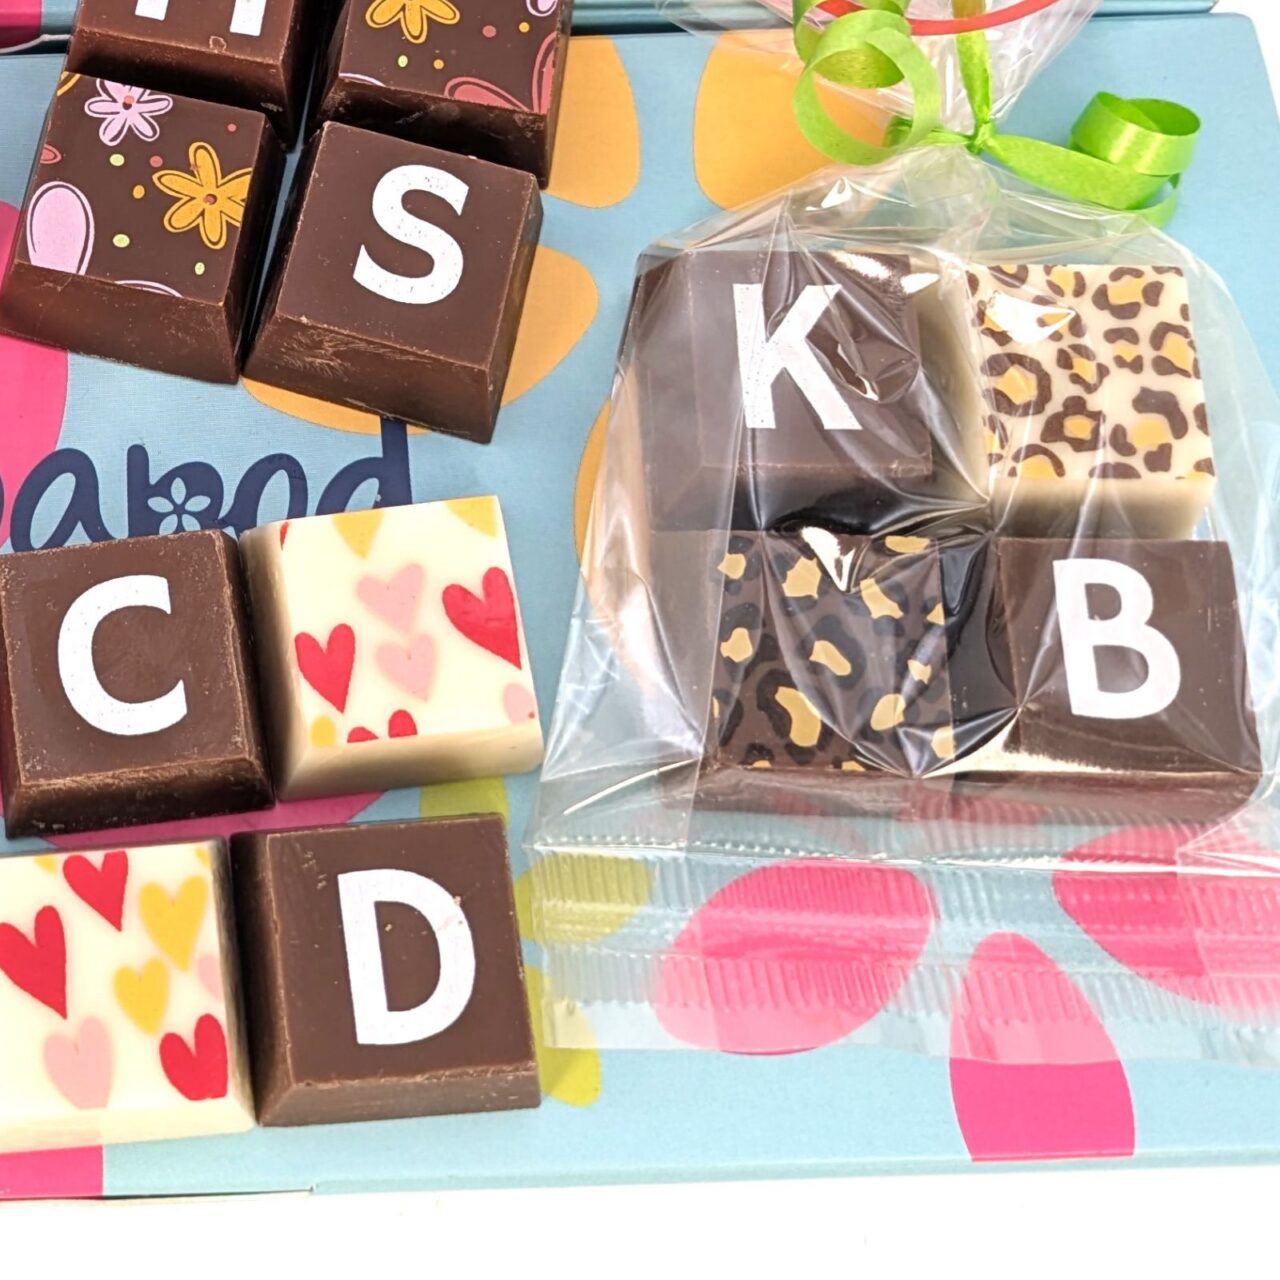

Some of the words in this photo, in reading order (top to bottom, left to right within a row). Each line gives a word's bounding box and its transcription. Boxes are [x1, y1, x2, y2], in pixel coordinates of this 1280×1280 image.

[353, 165, 468, 304] S
[733, 280, 862, 431] K
[58, 575, 187, 735] C
[1052, 560, 1180, 719] B
[338, 869, 475, 1044] D
